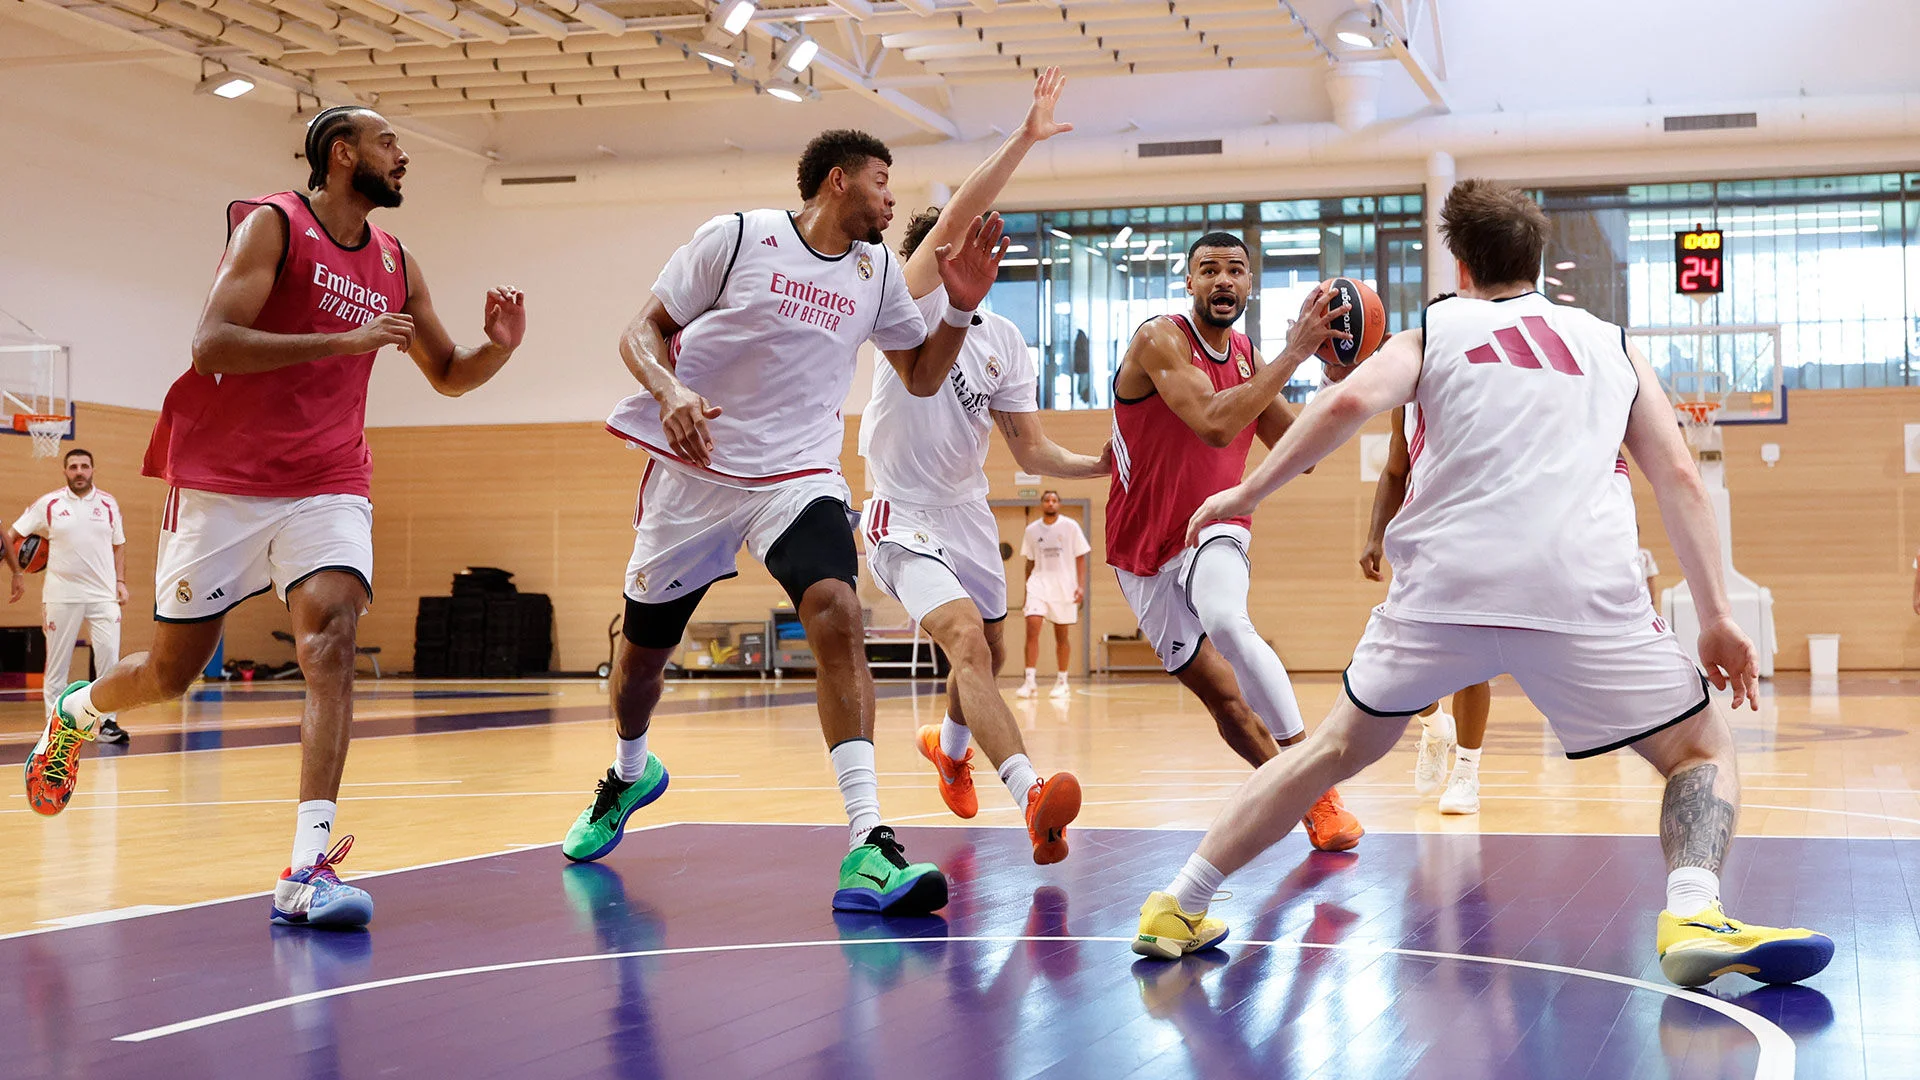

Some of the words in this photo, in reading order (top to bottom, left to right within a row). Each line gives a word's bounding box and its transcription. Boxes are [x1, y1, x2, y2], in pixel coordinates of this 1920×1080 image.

[313, 262, 388, 312] Emirates
[1681, 257, 1719, 290] 24
[319, 292, 340, 313] FLY
[336, 300, 375, 326] BETTER
[770, 272, 856, 316] Emirates
[1341, 287, 1352, 334] uroague
[778, 299, 800, 318] FLY
[800, 305, 841, 332] BETTER
